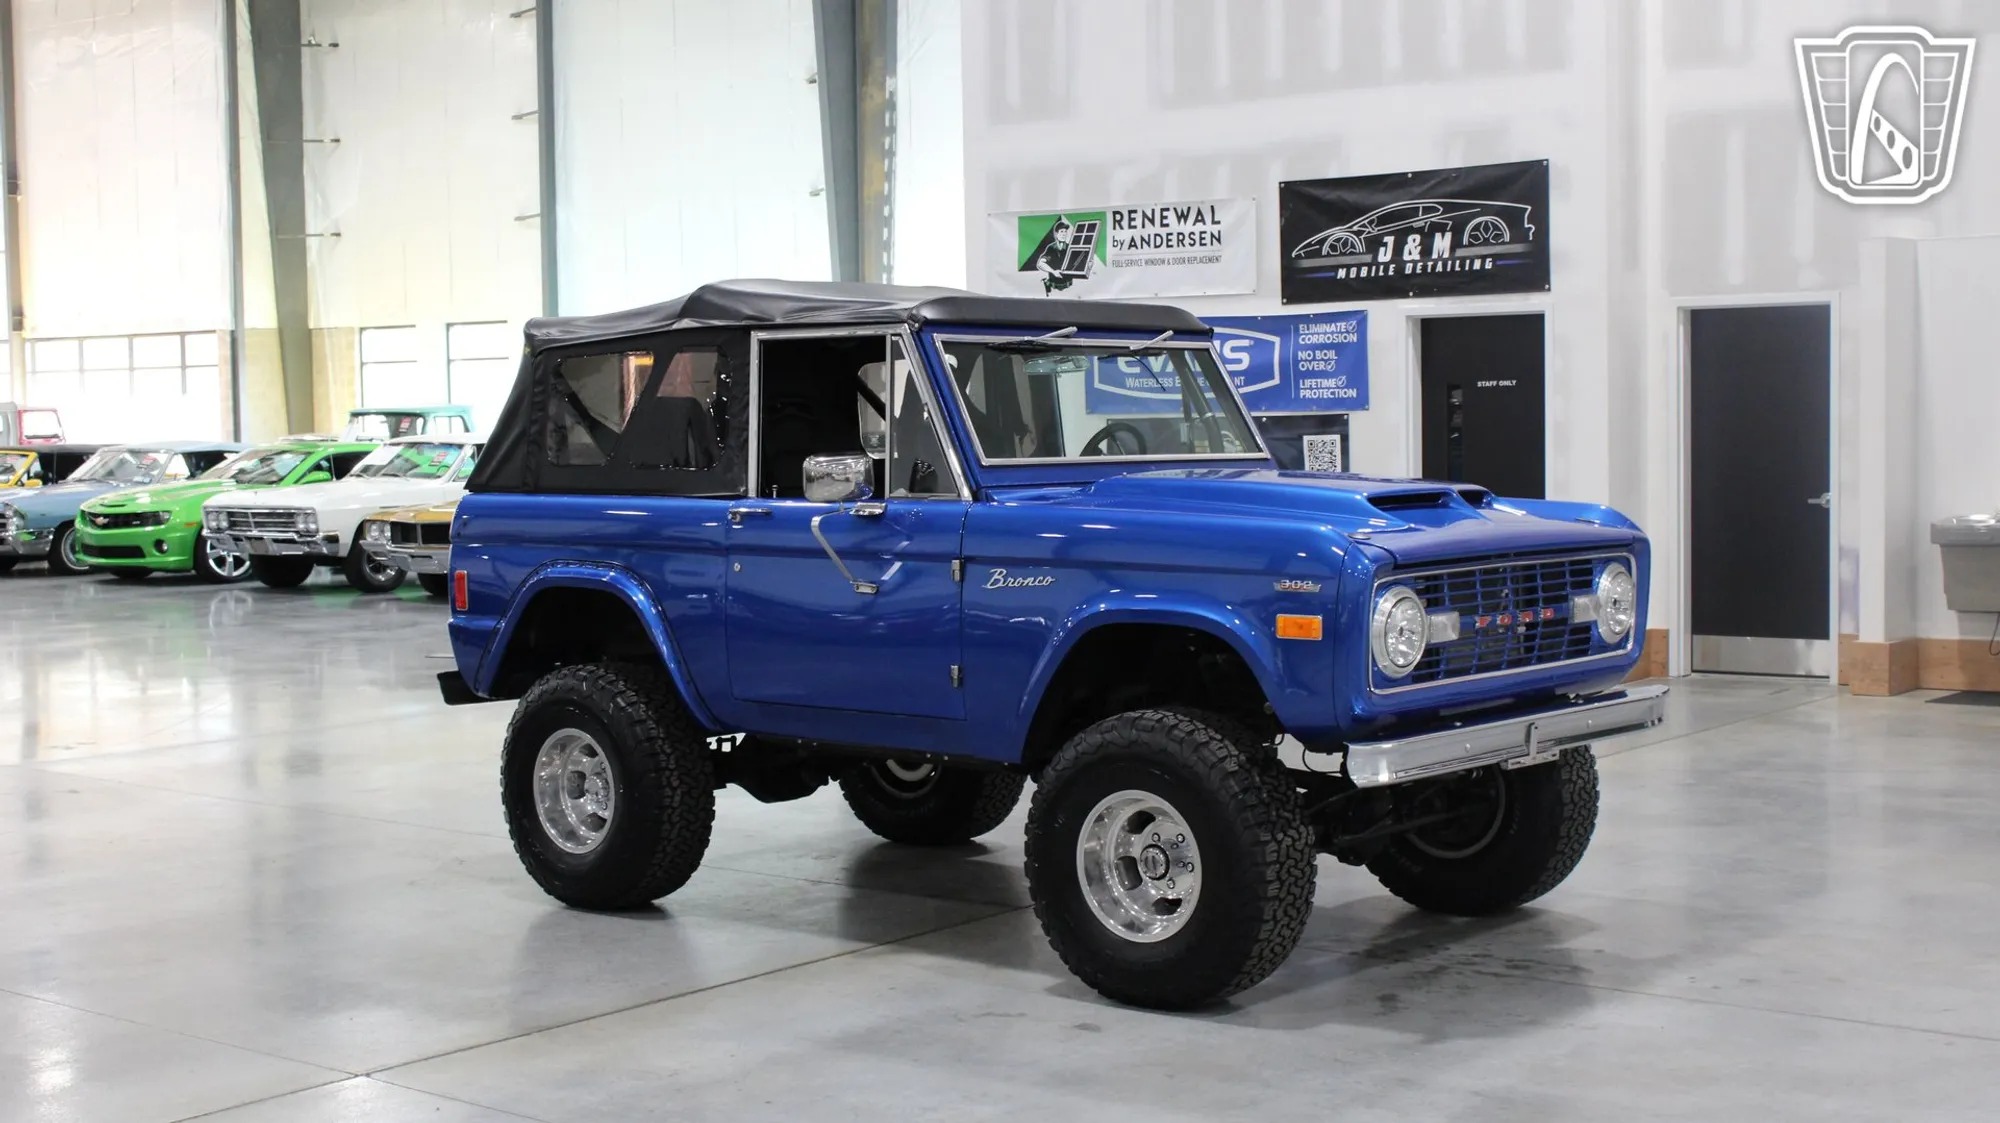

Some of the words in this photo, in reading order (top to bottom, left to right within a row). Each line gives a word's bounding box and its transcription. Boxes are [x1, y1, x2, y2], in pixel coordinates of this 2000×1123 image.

[1112, 205, 1221, 231] RENEWAL
[1112, 236, 1125, 250] by
[1127, 230, 1222, 250] ANDERSEN
[1377, 236, 1395, 263] J
[1402, 234, 1421, 261] &
[1431, 232, 1453, 259] M
[1144, 258, 1166, 267] WINDOW
[1172, 257, 1186, 266] DOOR
[1187, 255, 1222, 265] REPLACEMENT
[1336, 264, 1396, 280] MOBILE
[1404, 258, 1493, 274] DETAILING
[1299, 322, 1347, 334] ELIMINATE
[1299, 333, 1357, 344] CORROSION
[1298, 350, 1313, 360] NO
[1315, 350, 1338, 360] BOIL
[1299, 361, 1326, 371] OVER
[1299, 379, 1337, 389] LIFETIME
[1299, 388, 1357, 399] PROTECTION
[981, 568, 1056, 589] Bronco
[1280, 579, 1312, 590] 302
[1474, 607, 1555, 629] FORD
